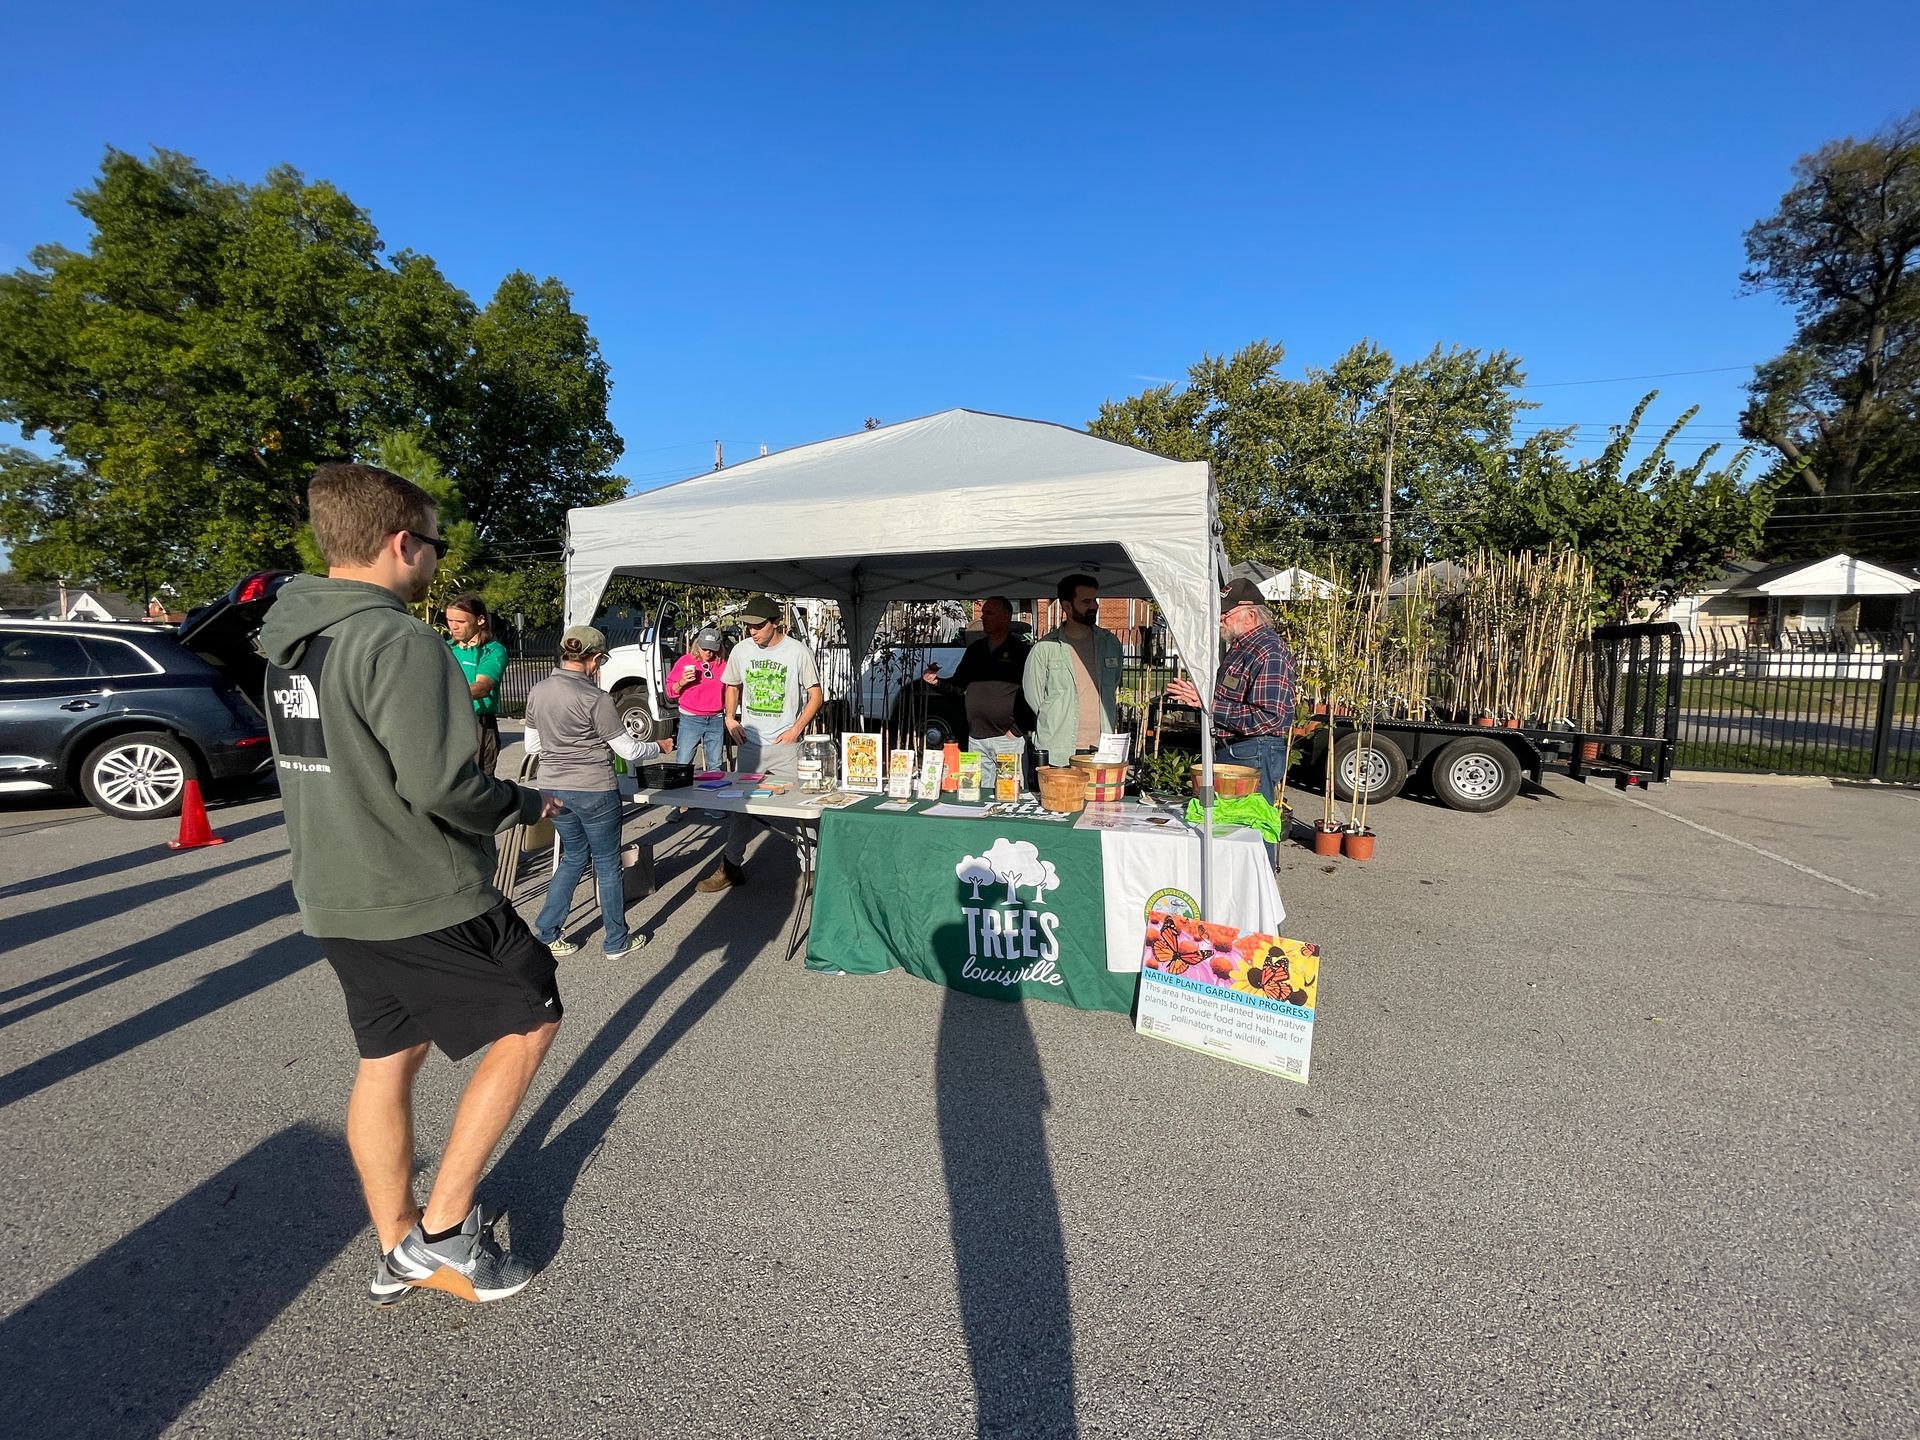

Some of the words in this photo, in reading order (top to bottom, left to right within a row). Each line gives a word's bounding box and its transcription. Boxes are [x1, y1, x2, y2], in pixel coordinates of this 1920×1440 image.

[274, 690, 304, 704] NORT
[284, 704, 304, 718] FAC
[962, 906, 1060, 961] TREES
[962, 956, 1064, 986] louisville
[1144, 970, 1173, 984] NATIVE
[1176, 978, 1203, 992] PLANT
[1206, 986, 1243, 1002] GARDEN
[1246, 997, 1256, 1006] IN
[1259, 1000, 1309, 1019] PROGRESS
[1146, 982, 1160, 993] This
[1162, 989, 1179, 998] area
[1182, 991, 1195, 1002] has
[1198, 998, 1218, 1008] been
[1220, 1003, 1254, 1019] planted
[1256, 1013, 1275, 1024] with
[1278, 1018, 1306, 1032] native
[1145, 994, 1168, 1007] plants
[1170, 1001, 1178, 1010] to
[1180, 1005, 1211, 1018] provide
[1214, 1013, 1234, 1025] food
[1236, 1020, 1252, 1030] and
[1255, 1024, 1287, 1040] habitat
[1290, 1034, 1304, 1044] for
[1171, 1014, 1214, 1032] pollinators
[1216, 1027, 1232, 1037] and
[1235, 1032, 1268, 1048] wildlife.
